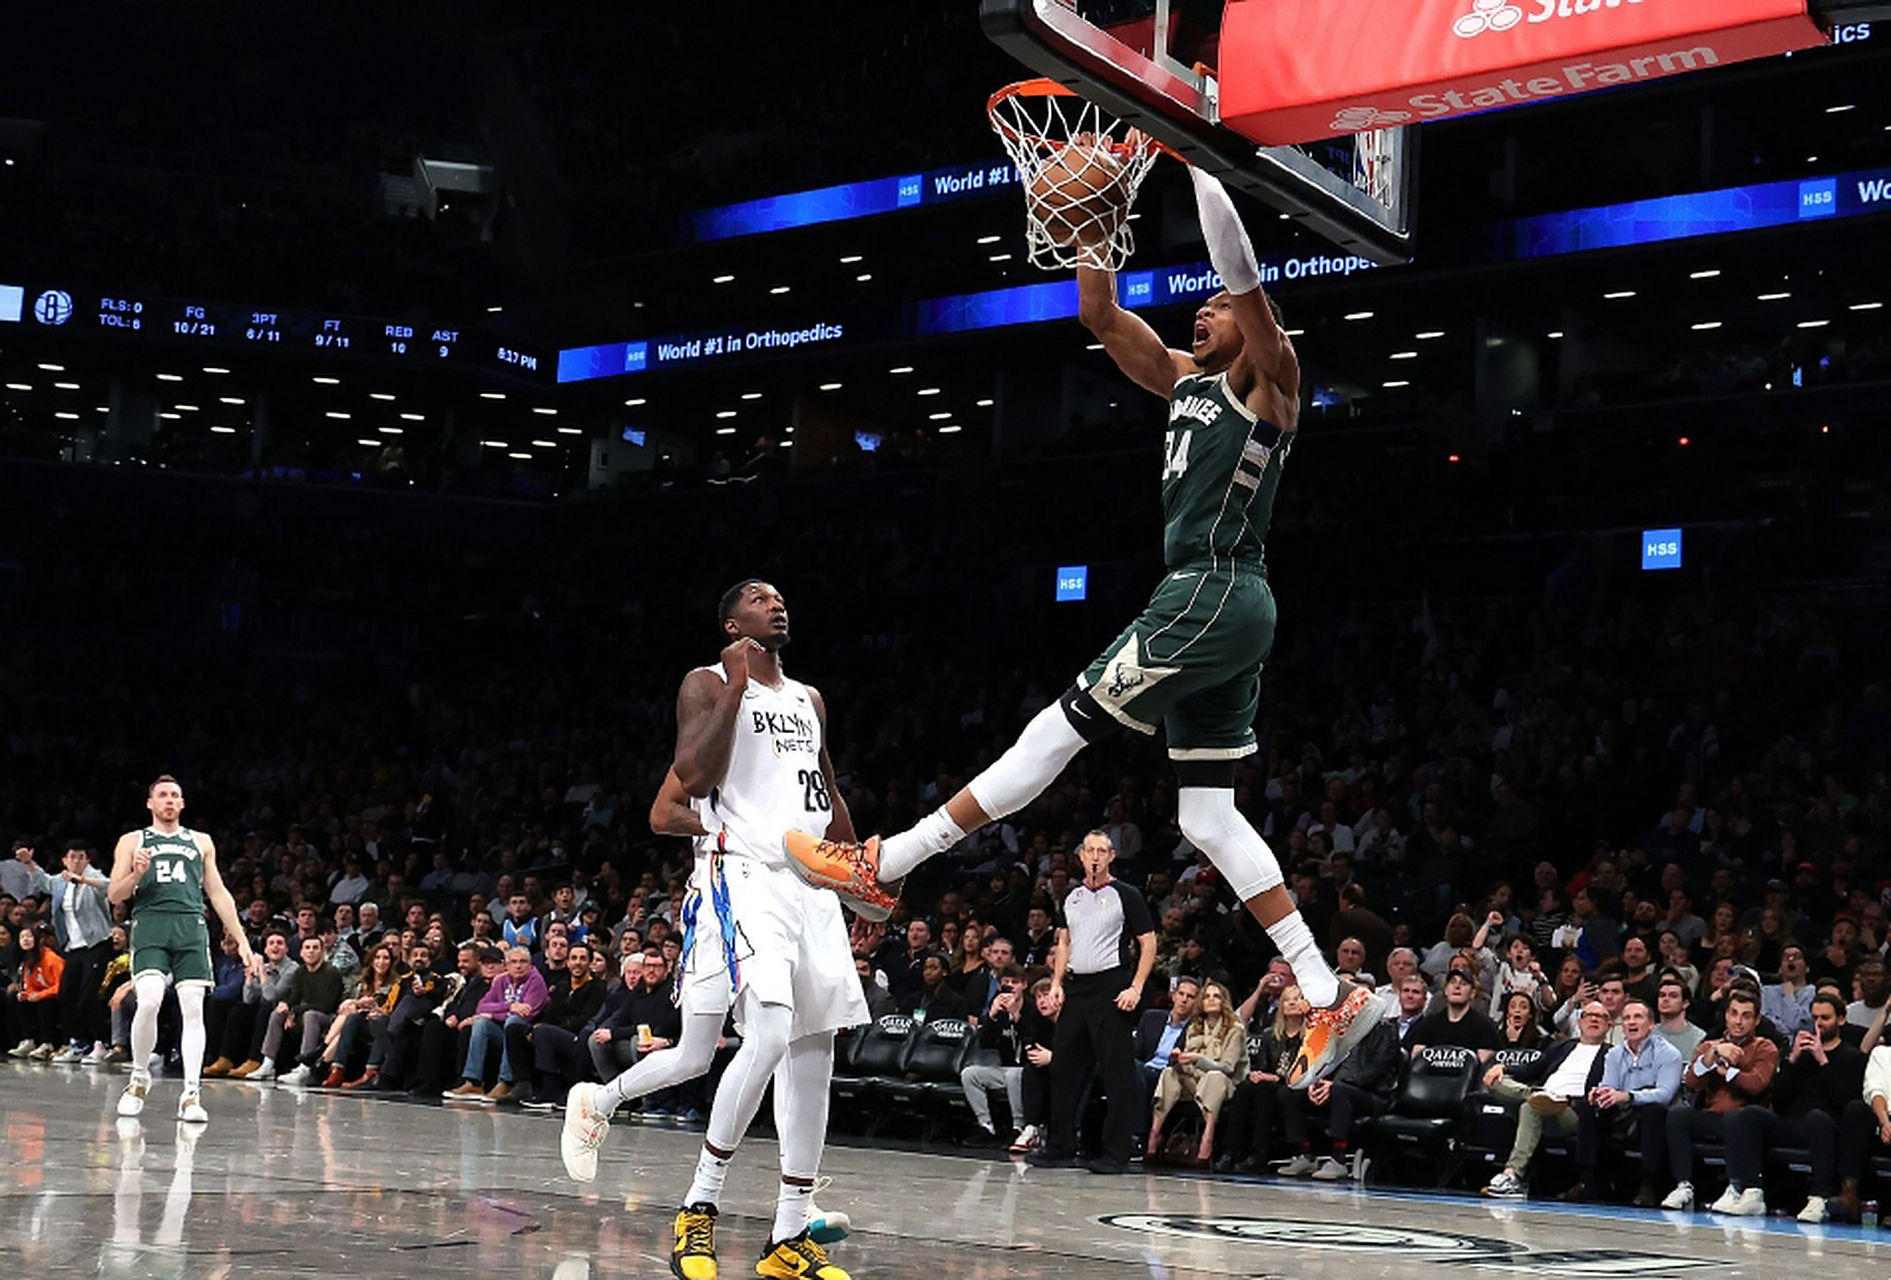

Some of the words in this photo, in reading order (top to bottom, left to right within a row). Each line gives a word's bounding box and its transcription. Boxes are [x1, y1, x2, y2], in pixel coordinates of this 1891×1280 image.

[934, 170, 984, 194] World
[988, 166, 1010, 186] #1
[1803, 191, 1832, 206] HSS
[1260, 263, 1279, 283] in
[1284, 254, 1378, 280] Orthope
[1128, 283, 1150, 296] HSS
[101, 299, 131, 312] FLS:
[133, 302, 143, 313] 0
[186, 306, 205, 318] FG
[99, 314, 131, 328] TOL:
[252, 312, 278, 325] 3PT
[323, 320, 341, 331] FT
[431, 330, 459, 343] AST
[658, 340, 700, 361] World
[704, 337, 724, 355] #1
[726, 335, 741, 353] in
[745, 322, 843, 349] Orthopedics
[391, 342, 407, 354] 10
[439, 346, 449, 358] 9
[520, 354, 537, 371] PM
[1647, 542, 1677, 557] HSS
[1060, 577, 1083, 590] HSS
[752, 711, 813, 737] BKLYN
[775, 738, 814, 753] NETS
[797, 769, 830, 812] 28
[155, 860, 187, 883] 24
[1422, 1048, 1467, 1062] QATAR
